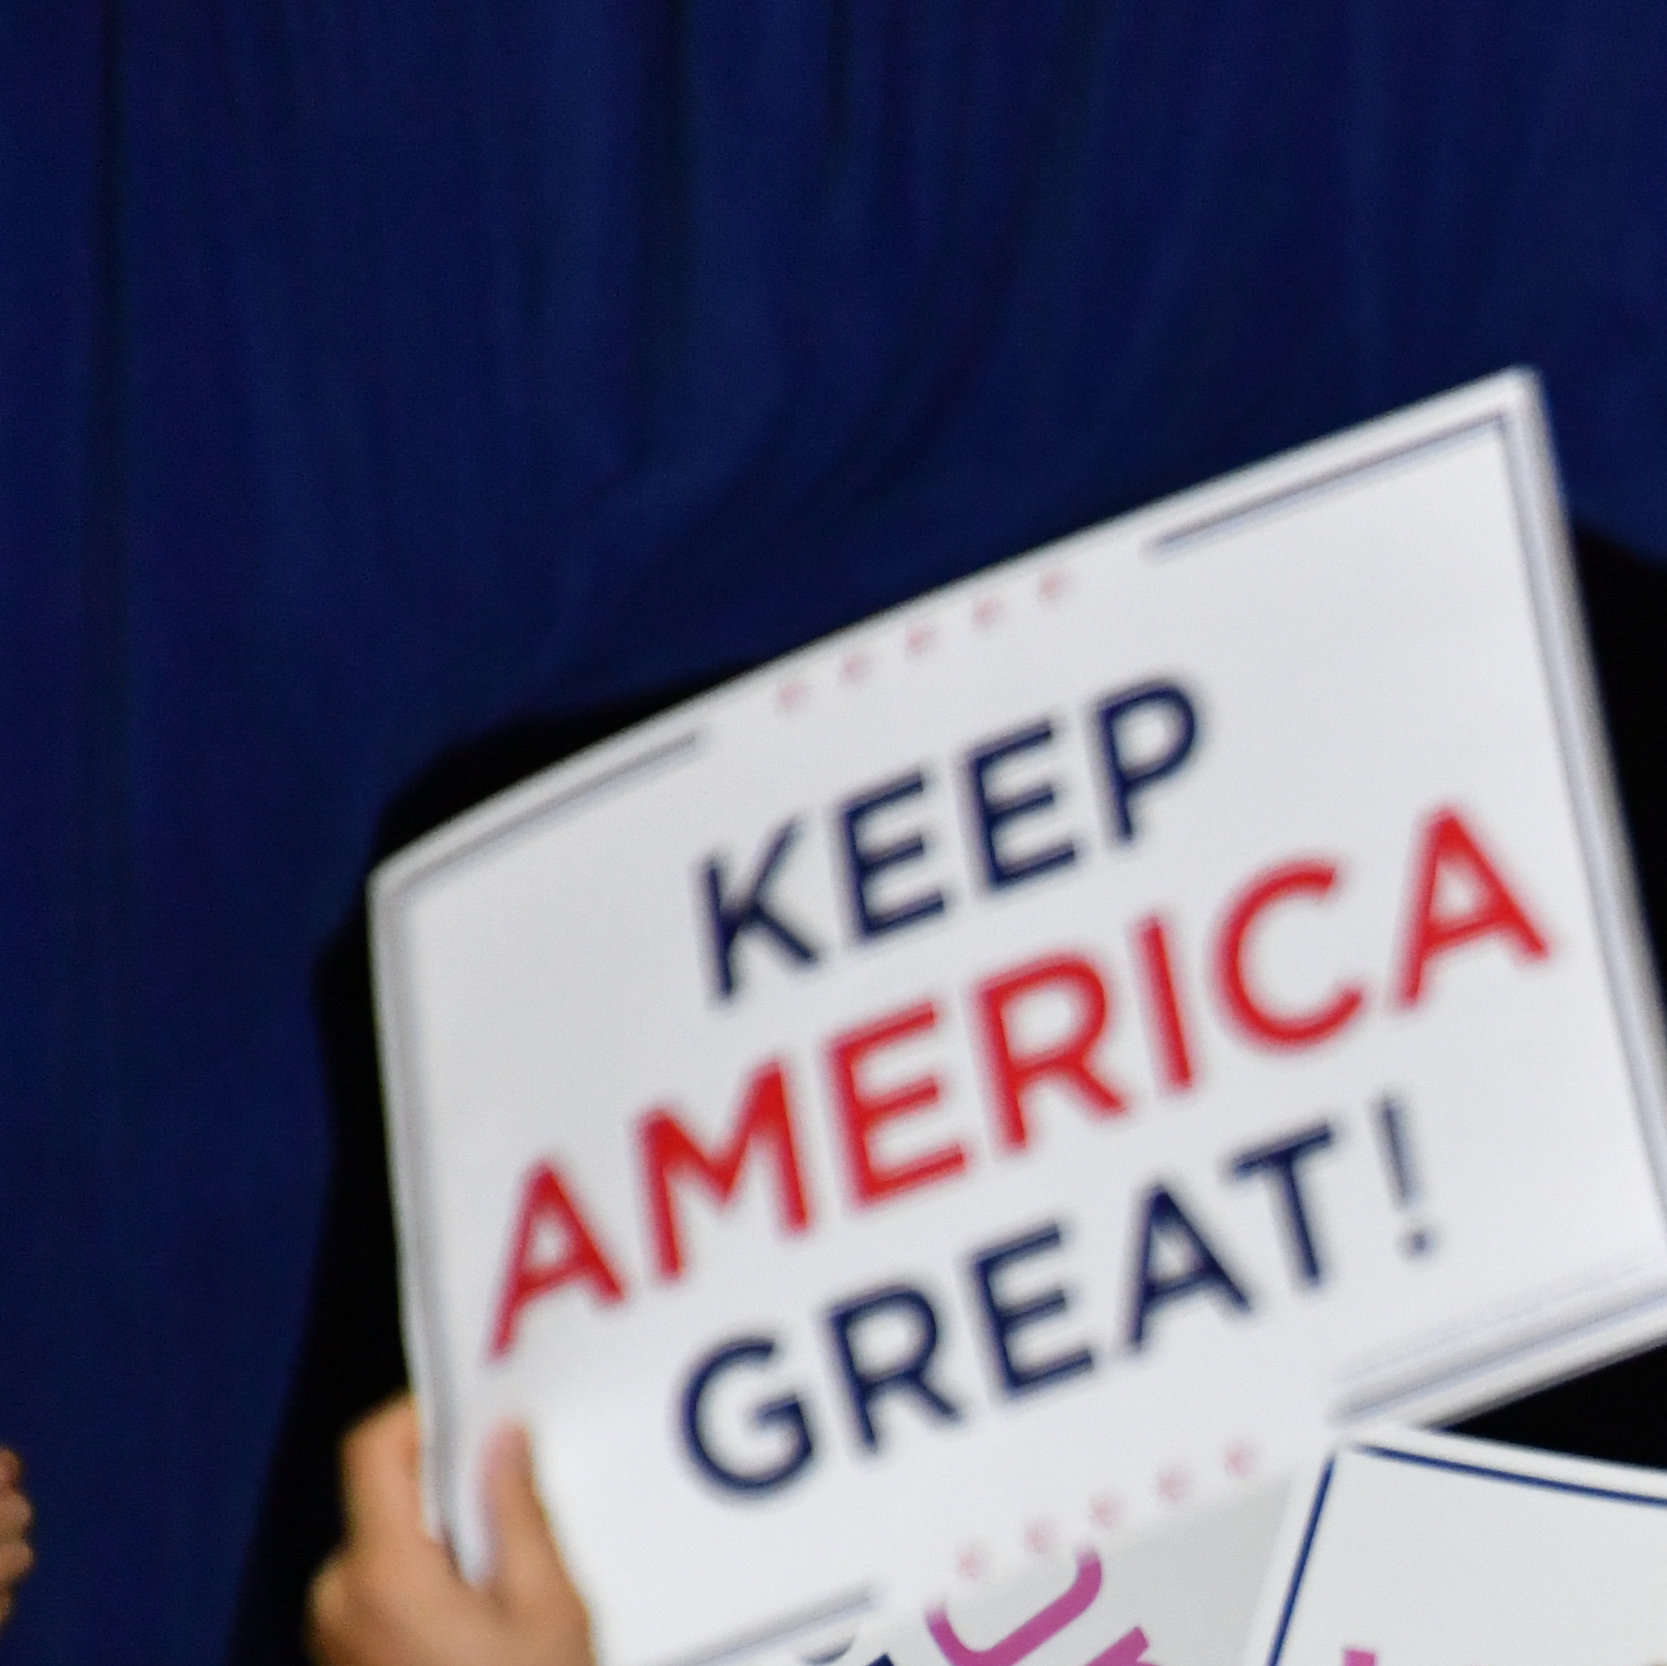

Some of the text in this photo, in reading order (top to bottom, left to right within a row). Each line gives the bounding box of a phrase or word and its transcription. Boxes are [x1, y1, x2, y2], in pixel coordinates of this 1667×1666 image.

[695, 672, 1208, 1006] KEEP
[483, 802, 1553, 1366] AMERICA
[680, 1090, 1440, 1504] GREAT!
